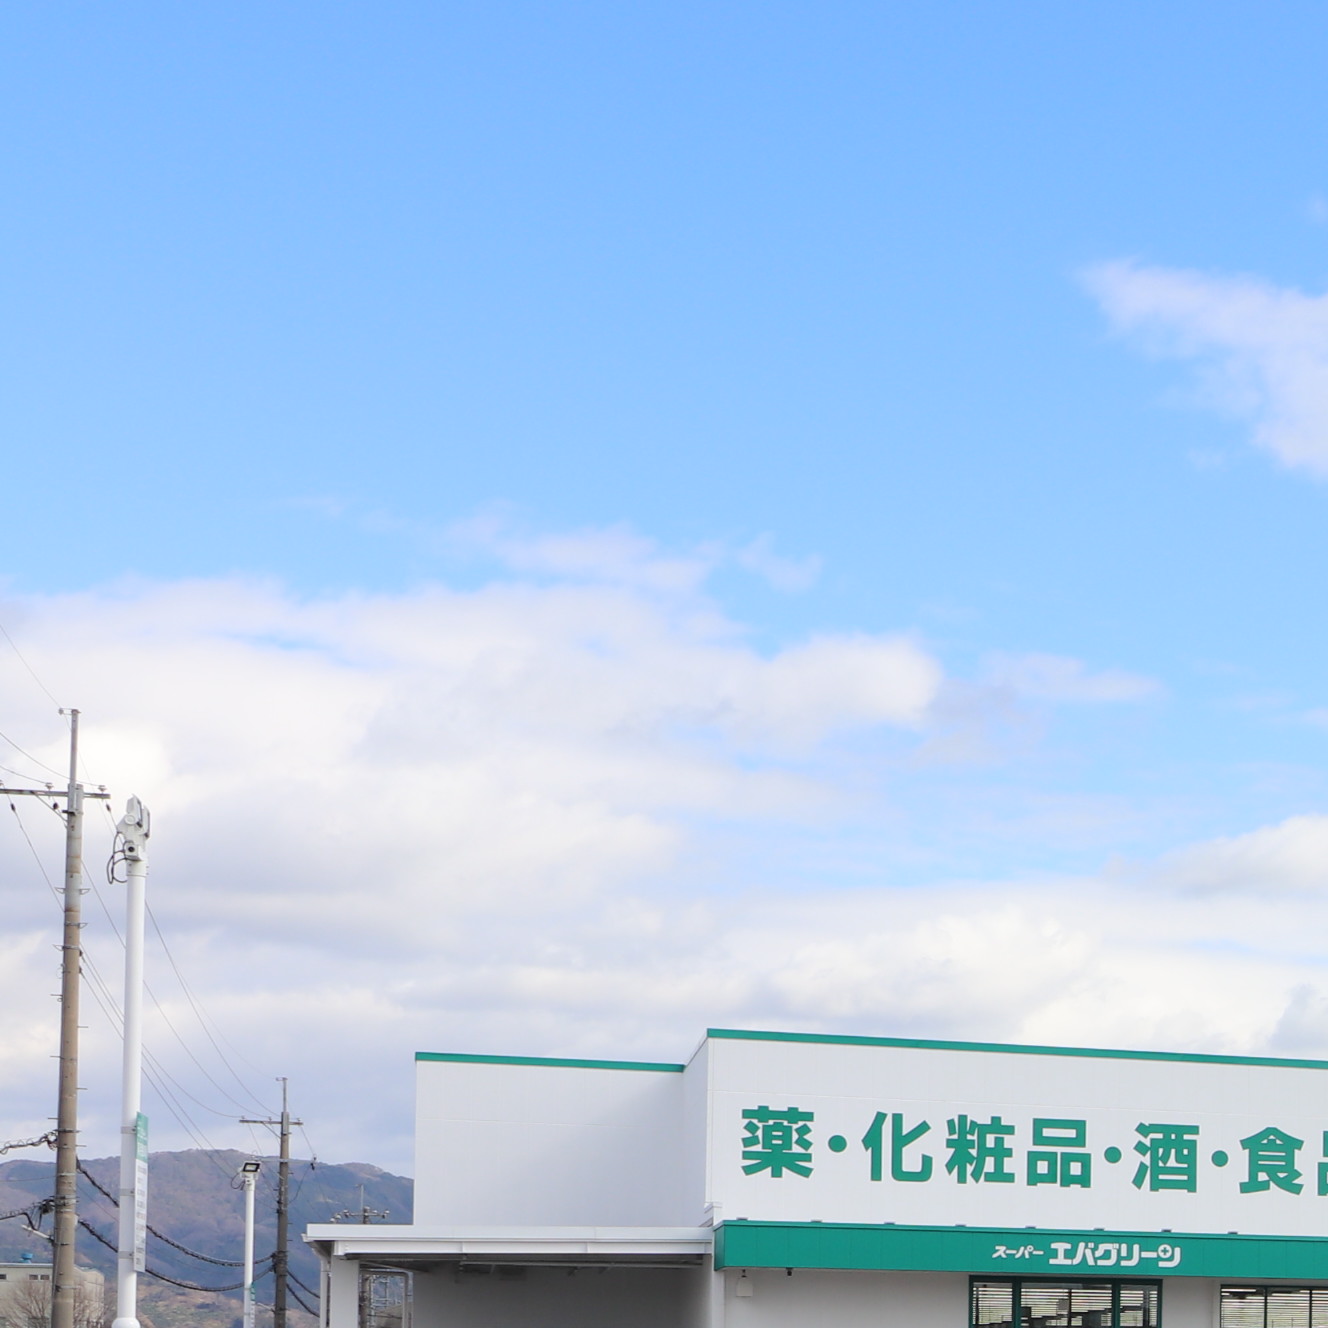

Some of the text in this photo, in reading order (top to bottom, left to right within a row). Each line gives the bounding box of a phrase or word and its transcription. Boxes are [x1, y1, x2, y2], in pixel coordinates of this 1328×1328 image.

[992, 1242, 1182, 1268] スーパー エバグリーン
